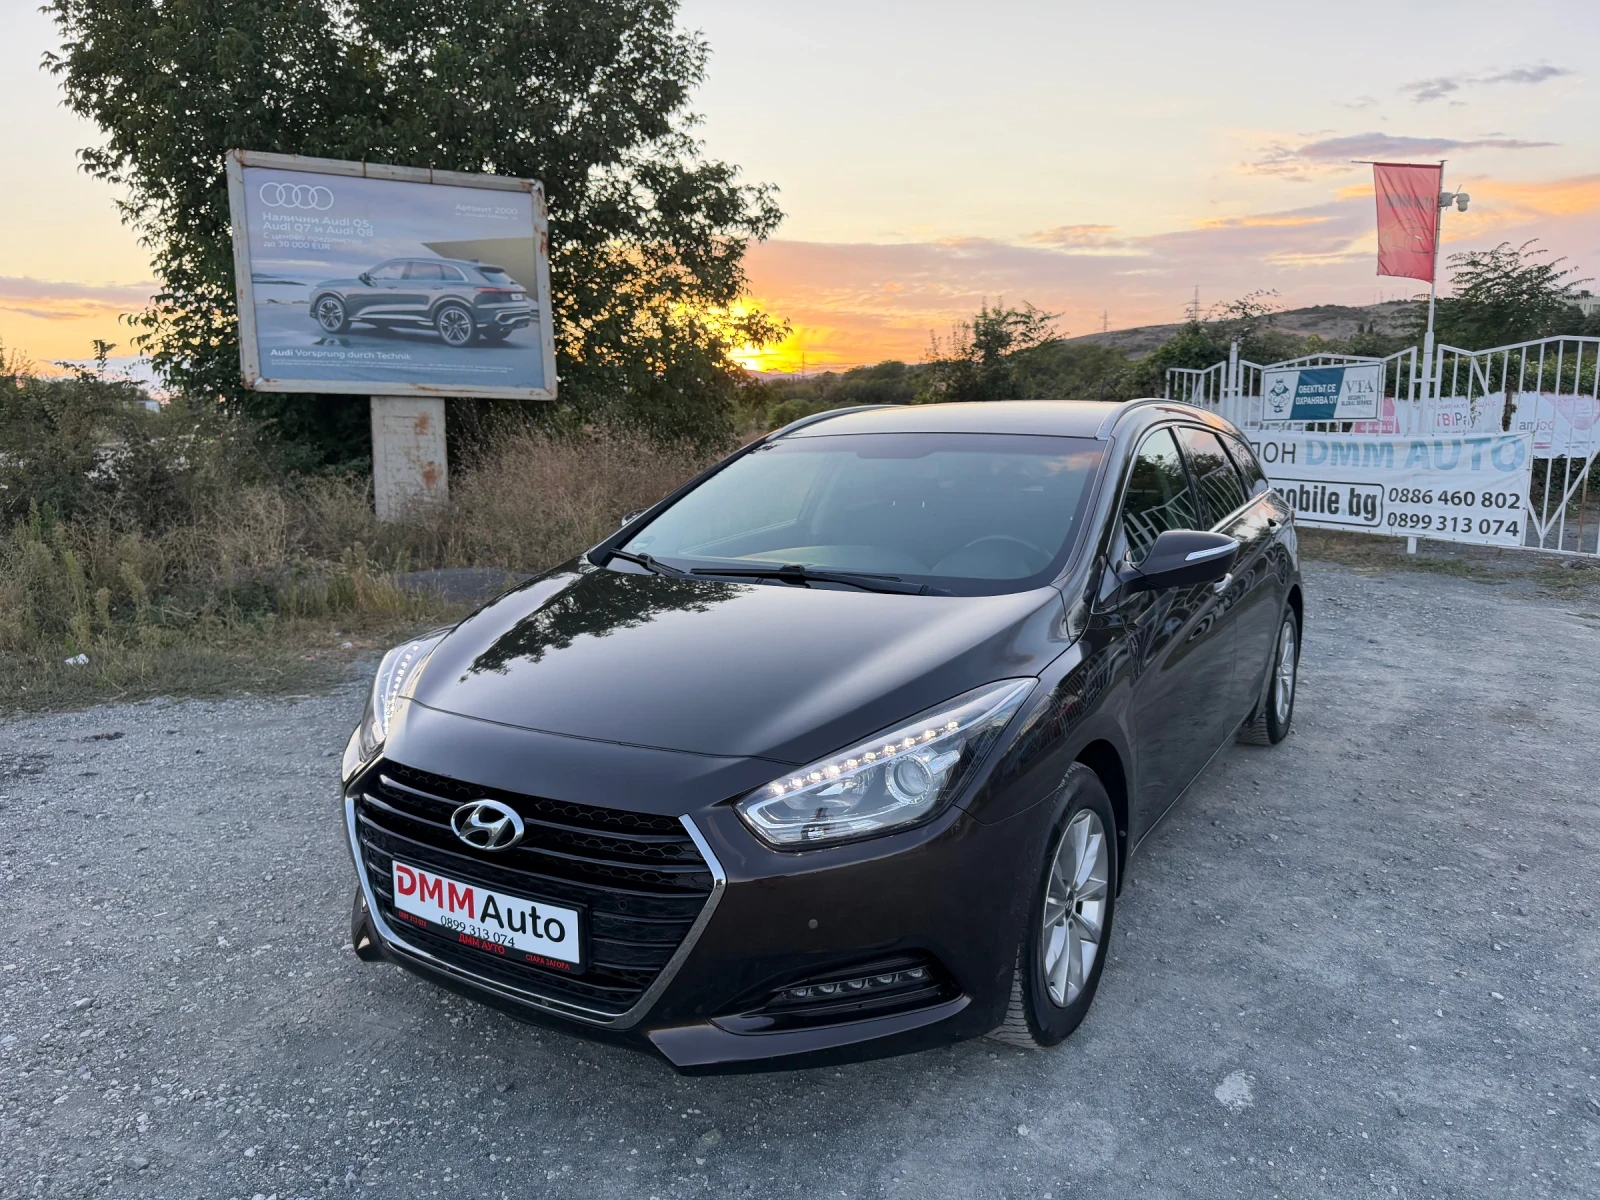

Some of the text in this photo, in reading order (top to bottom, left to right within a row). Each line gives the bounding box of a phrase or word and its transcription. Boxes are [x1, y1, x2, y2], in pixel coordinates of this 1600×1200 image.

[494, 206, 518, 215] 2000
[262, 212, 319, 224] Налични
[322, 216, 350, 226] Audi
[263, 222, 290, 231] Audi
[294, 223, 311, 233] Q7
[326, 226, 353, 236] Audi
[357, 227, 374, 238] Q8
[278, 240, 291, 248] 30
[291, 241, 310, 249] 000
[312, 242, 331, 250] EUR
[270, 348, 412, 360] Audi Vorsprung durch Technik
[1298, 383, 1337, 394] ОБЕКТЪТ СЕ
[1345, 379, 1374, 394] VTA
[1295, 395, 1339, 405] ОХРАНЯВА ОТ
[1305, 439, 1395, 468] DMM
[1404, 435, 1526, 472] AUTO
[1388, 487, 1521, 510] 0886 460 802
[1387, 512, 1519, 537] 0899 313 074
[440, 915, 516, 948] 0899 313 074
[458, 932, 505, 955] ДММ АУТО
[525, 953, 571, 971] СТАРА ЗАГОРА
